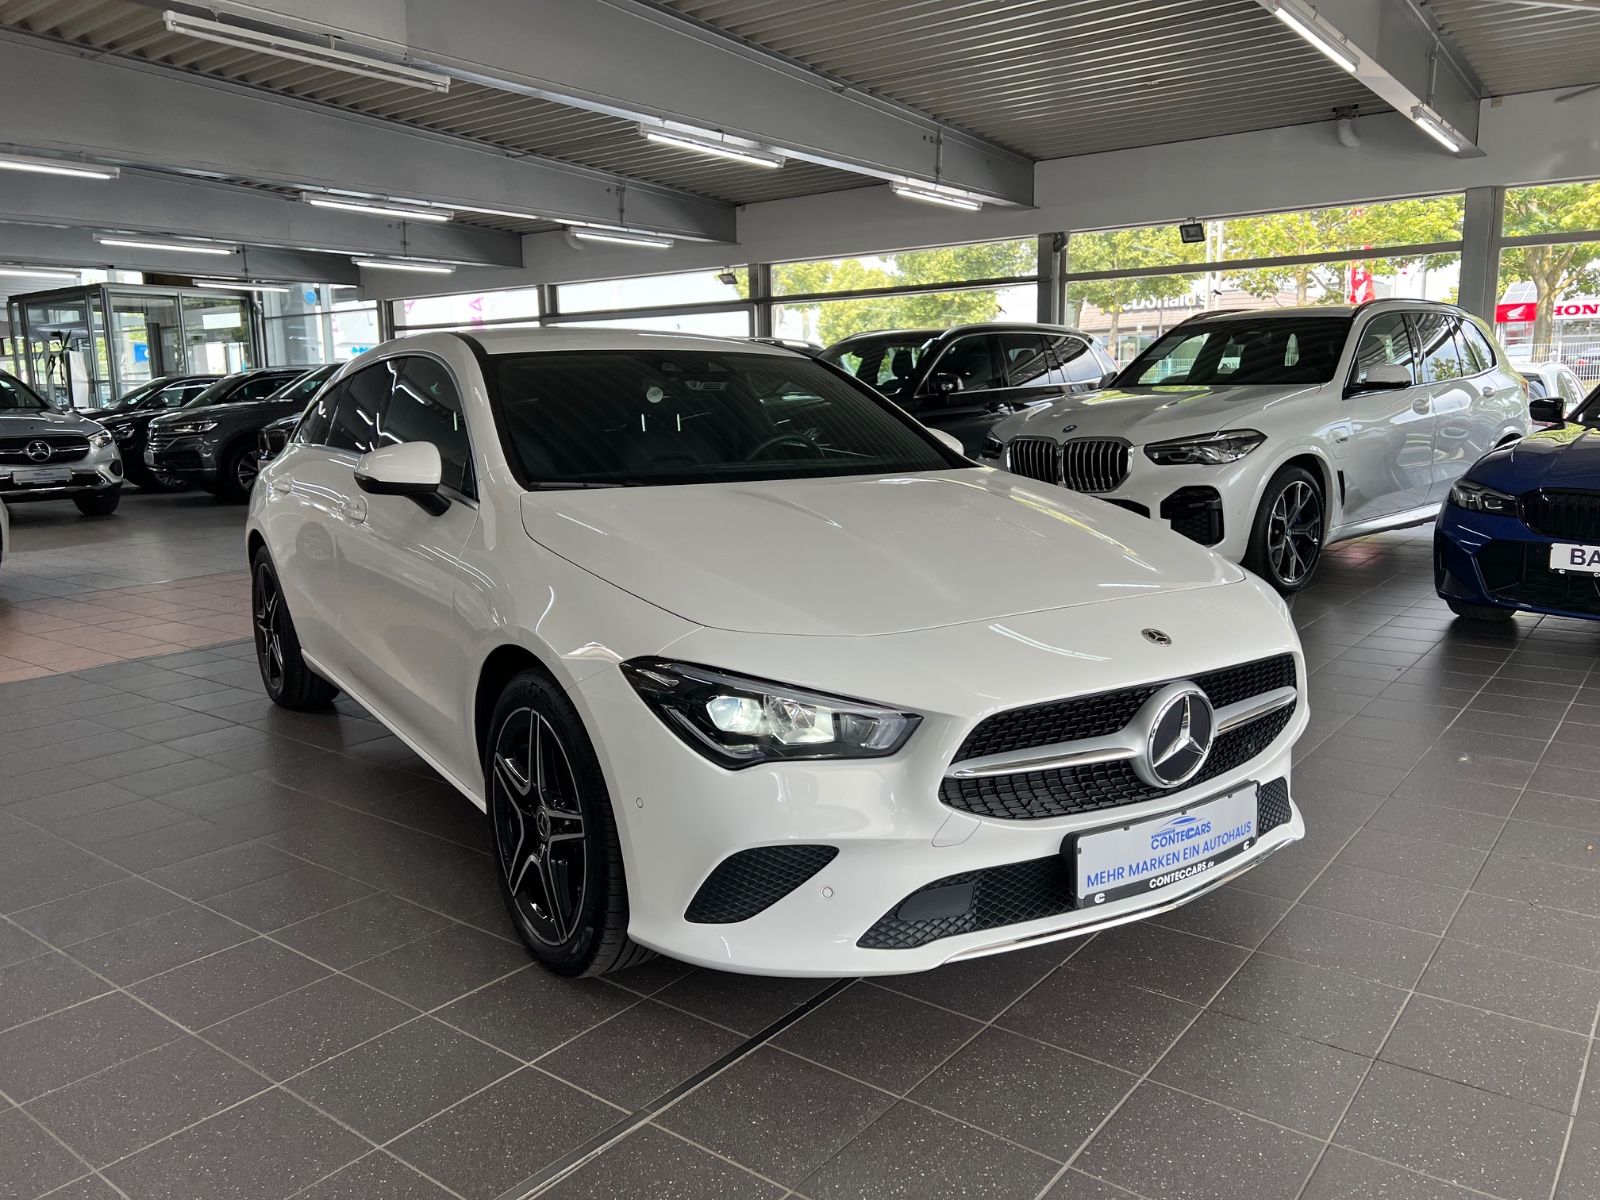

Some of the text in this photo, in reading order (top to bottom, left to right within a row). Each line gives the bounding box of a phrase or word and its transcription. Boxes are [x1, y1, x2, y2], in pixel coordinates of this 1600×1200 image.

[1087, 866, 1125, 888] MEHR
[1129, 851, 1180, 877] MARKEN
[1183, 842, 1200, 861] EIN
[1202, 821, 1252, 854] AUTOHAUS
